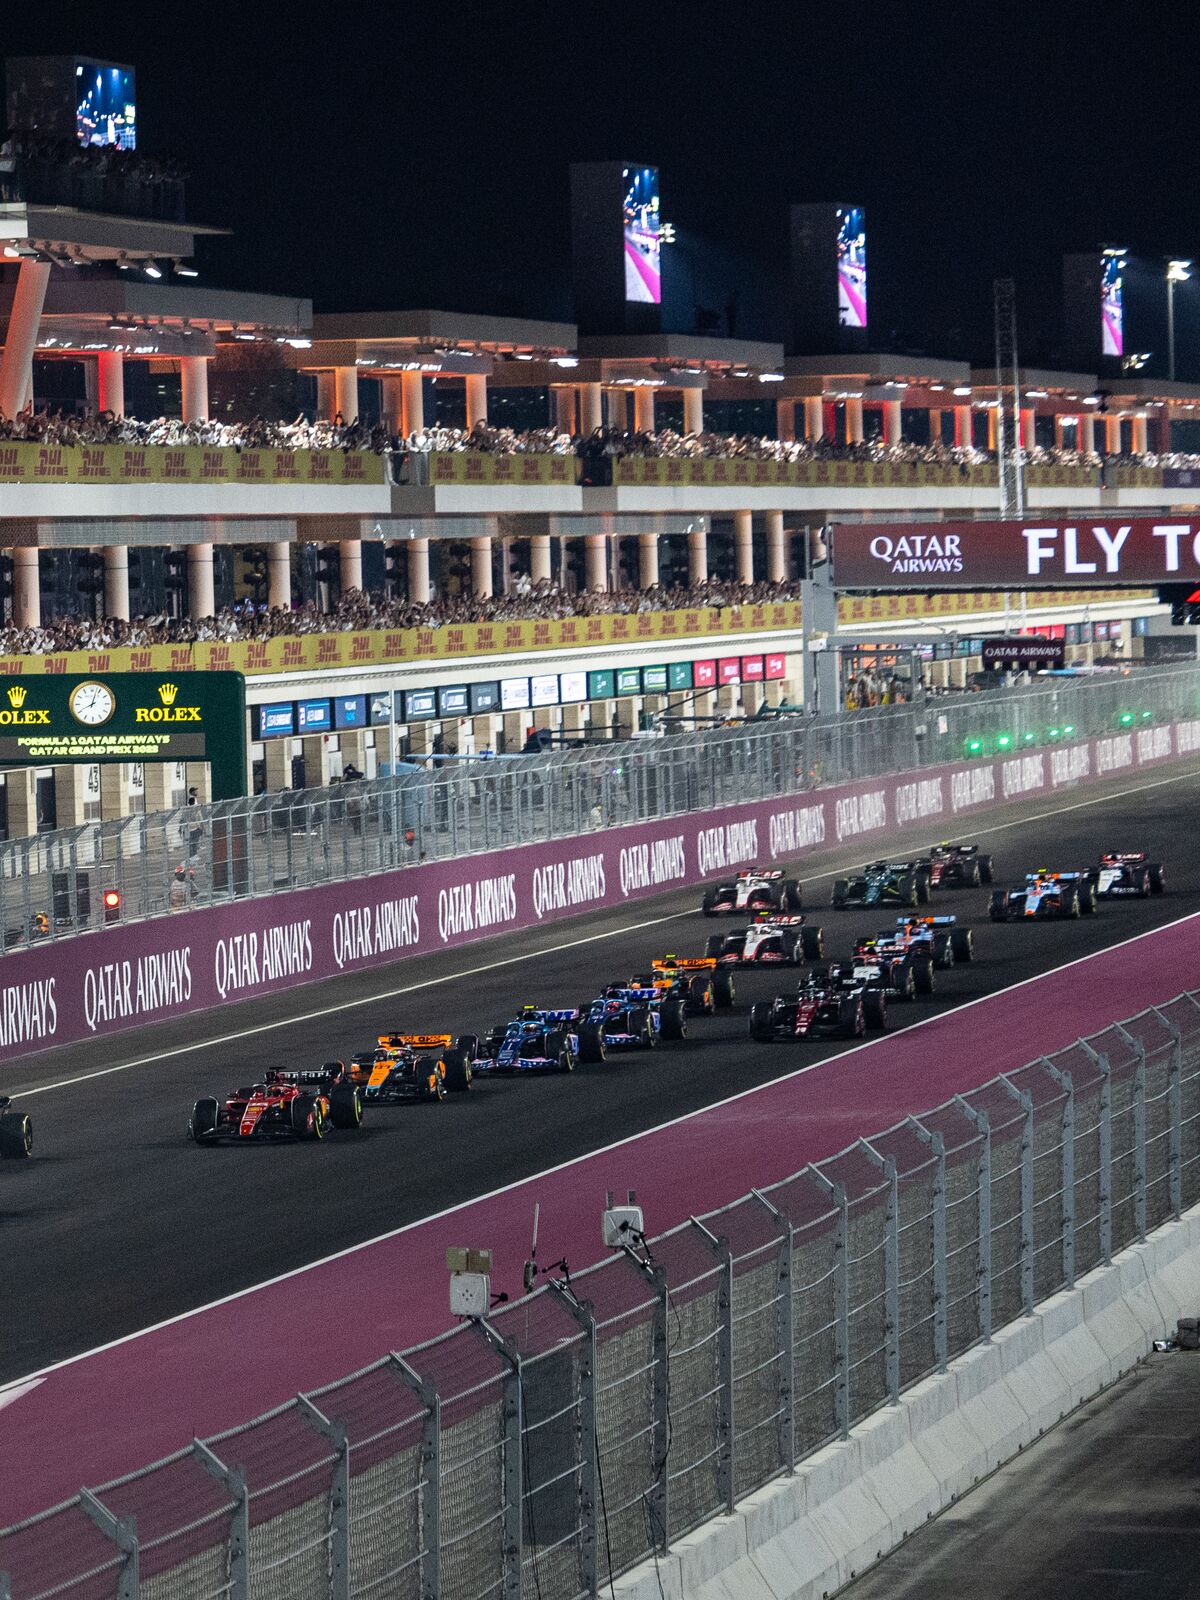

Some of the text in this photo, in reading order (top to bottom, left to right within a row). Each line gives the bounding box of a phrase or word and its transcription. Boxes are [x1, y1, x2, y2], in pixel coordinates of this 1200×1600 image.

[869, 535, 962, 563] QATAR
[892, 557, 963, 573] AIRWAYS
[1021, 525, 1200, 575] FLY T
[210, 648, 231, 670] DHL
[985, 646, 1062, 656] QATAR AIRWAYS
[136, 708, 202, 722] ROLEX
[17, 737, 70, 746] FORMULA
[78, 736, 117, 745] QATAR
[118, 735, 170, 744] AIRWAYS
[29, 747, 68, 756] QATAR
[69, 746, 106, 755] GRAND
[107, 745, 132, 754] PRIX
[620, 835, 685, 896] QATAR AIRWAYS
[698, 819, 757, 876] QATAR AIRWAYS
[439, 874, 516, 942] QATAR AIRWAYS
[533, 854, 605, 919] QATAR AIRWAYS
[333, 896, 419, 968] QATAR AIRWAYS
[215, 920, 312, 998] QATAR AIRWAYS
[84, 947, 191, 1031] QATAR AIRWAYS
